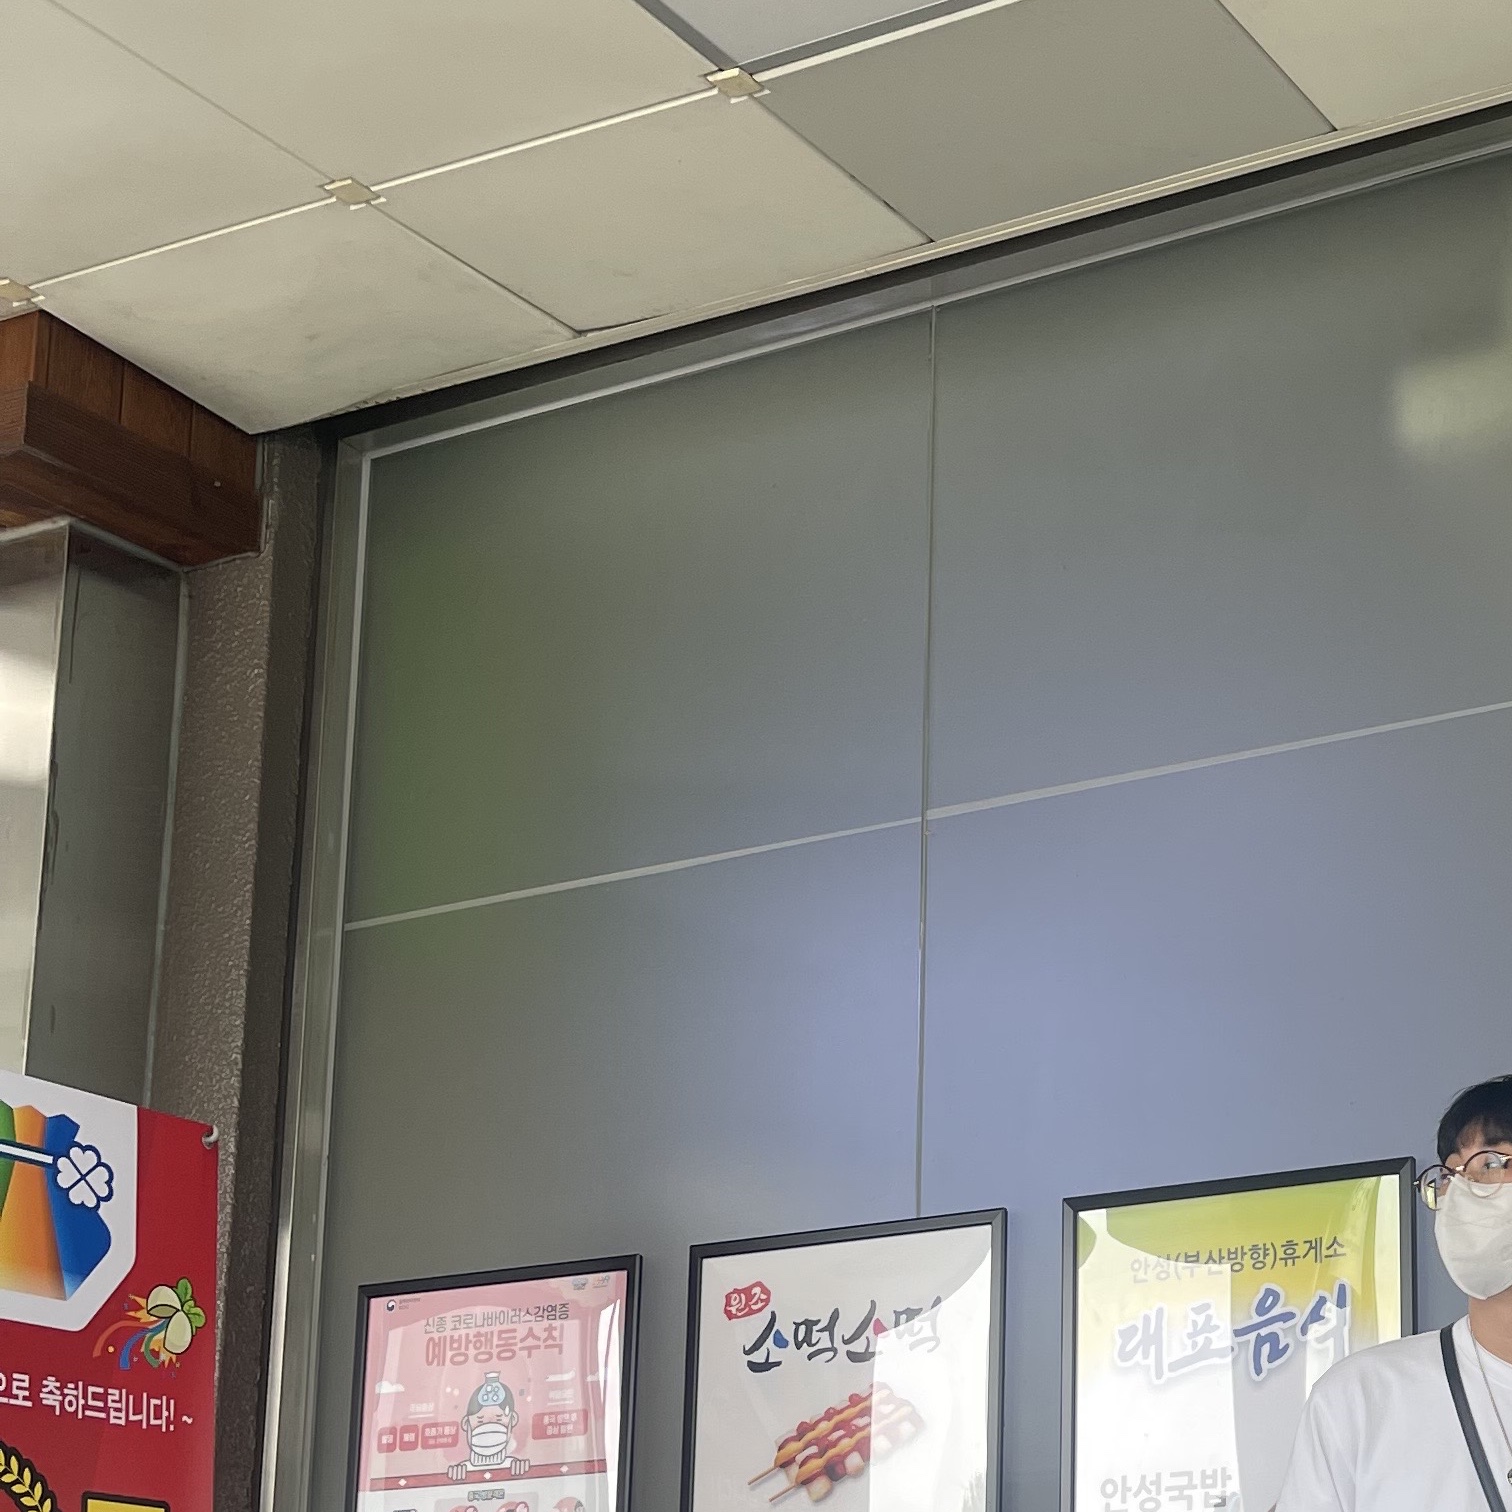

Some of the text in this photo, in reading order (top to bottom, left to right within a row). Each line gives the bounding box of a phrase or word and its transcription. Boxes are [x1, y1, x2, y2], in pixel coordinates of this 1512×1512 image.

[1130, 1235, 1347, 1284] 안성(부산방향)휴게소
[423, 1315, 448, 1335] 신종
[450, 1302, 570, 1332] 코로나바이러스감염증
[729, 1286, 768, 1317] 원조
[424, 1323, 564, 1367] 예방행동수칙
[743, 1296, 942, 1373] 소떡소떡
[1117, 1283, 1348, 1381] 대표 음식
[39, 1376, 175, 1432] 축하드립니다!
